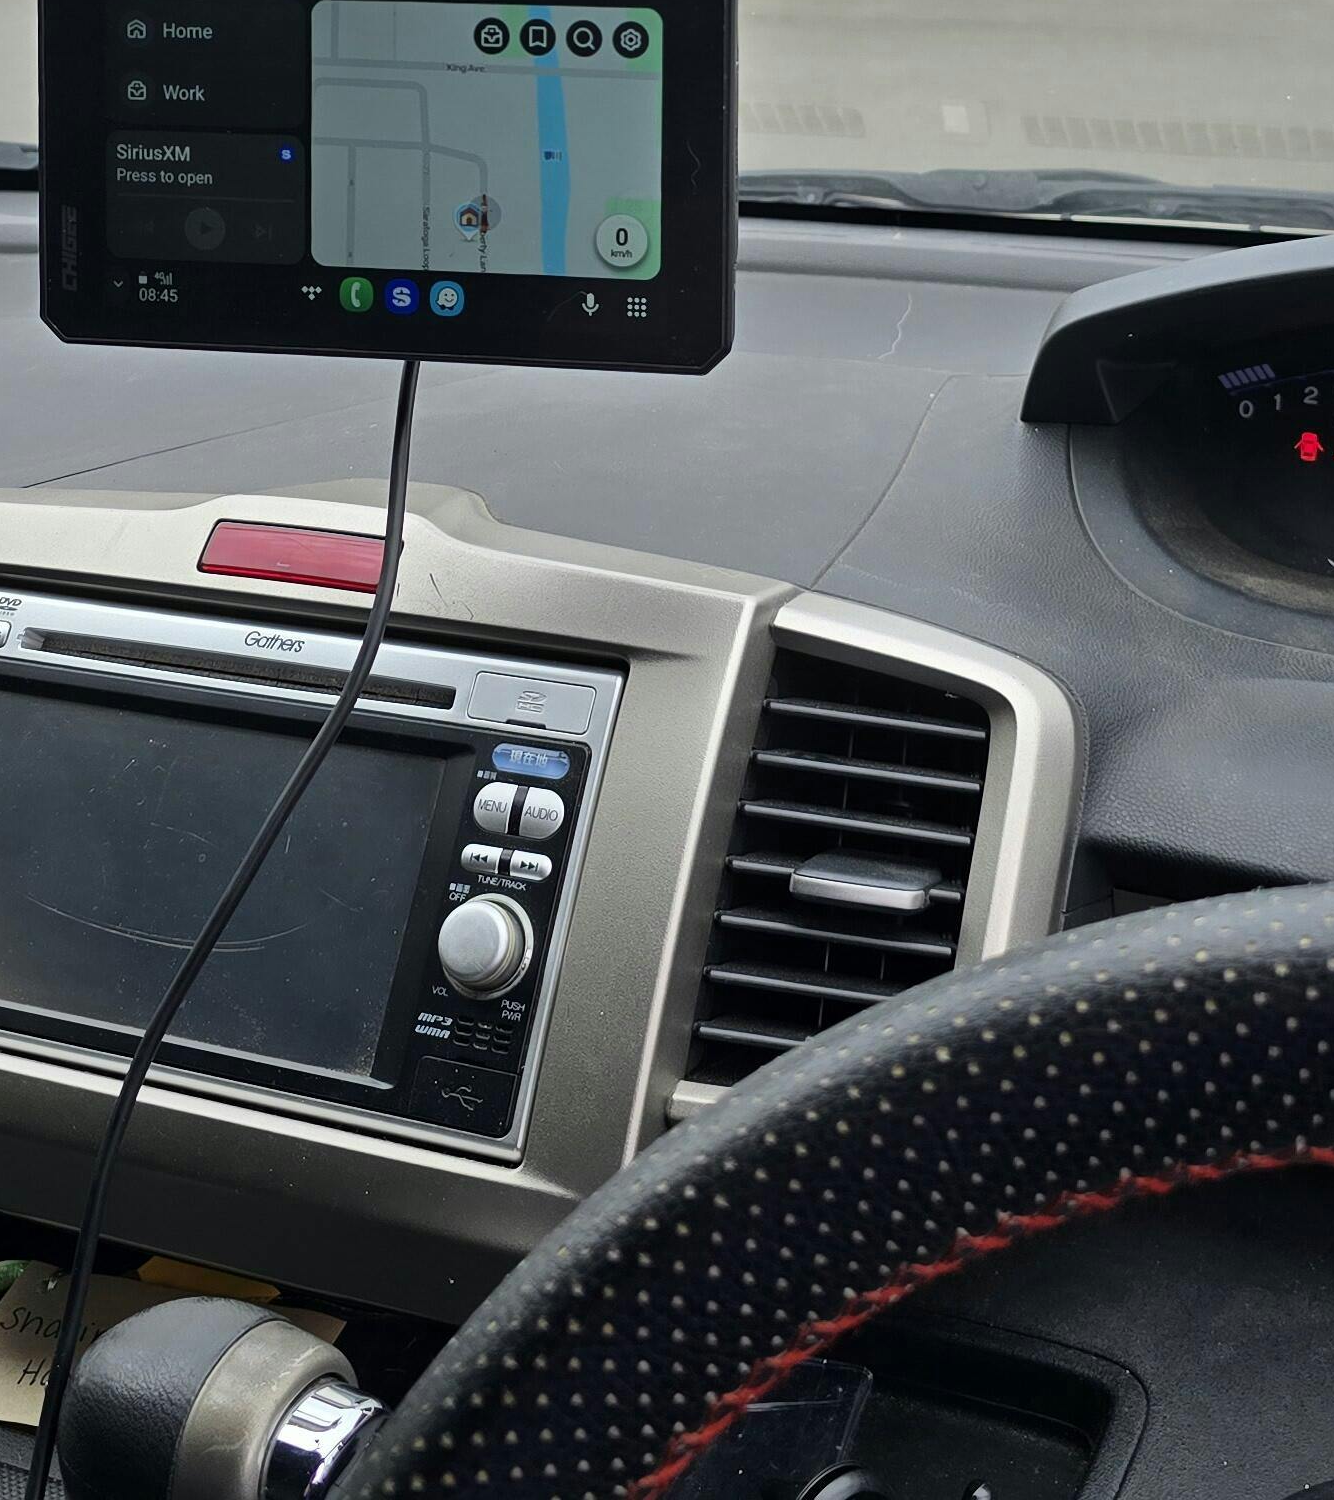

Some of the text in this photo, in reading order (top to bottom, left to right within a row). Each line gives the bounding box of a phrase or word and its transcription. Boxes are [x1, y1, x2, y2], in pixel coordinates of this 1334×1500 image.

[163, 22, 213, 39] Home
[163, 84, 206, 101] Work
[116, 143, 191, 162] SiriusXM
[117, 167, 213, 187] Press to open
[615, 227, 629, 247] 0
[610, 249, 633, 259] km/h
[138, 287, 179, 303] 08:45
[1238, 400, 1254, 418] 0
[1273, 393, 1282, 411] 1
[1303, 386, 1318, 404] 2
[244, 630, 305, 653] Gathers
[510, 749, 548, 767] 現在地
[477, 798, 508, 813] MENU
[523, 805, 558, 822] AUDIO
[477, 874, 527, 891] TUNE/TRACK
[449, 891, 467, 902] OFF
[431, 984, 449, 997] VOL
[500, 999, 526, 1012] PUSH
[417, 1011, 453, 1026] MP3
[501, 1009, 522, 1022] PWR
